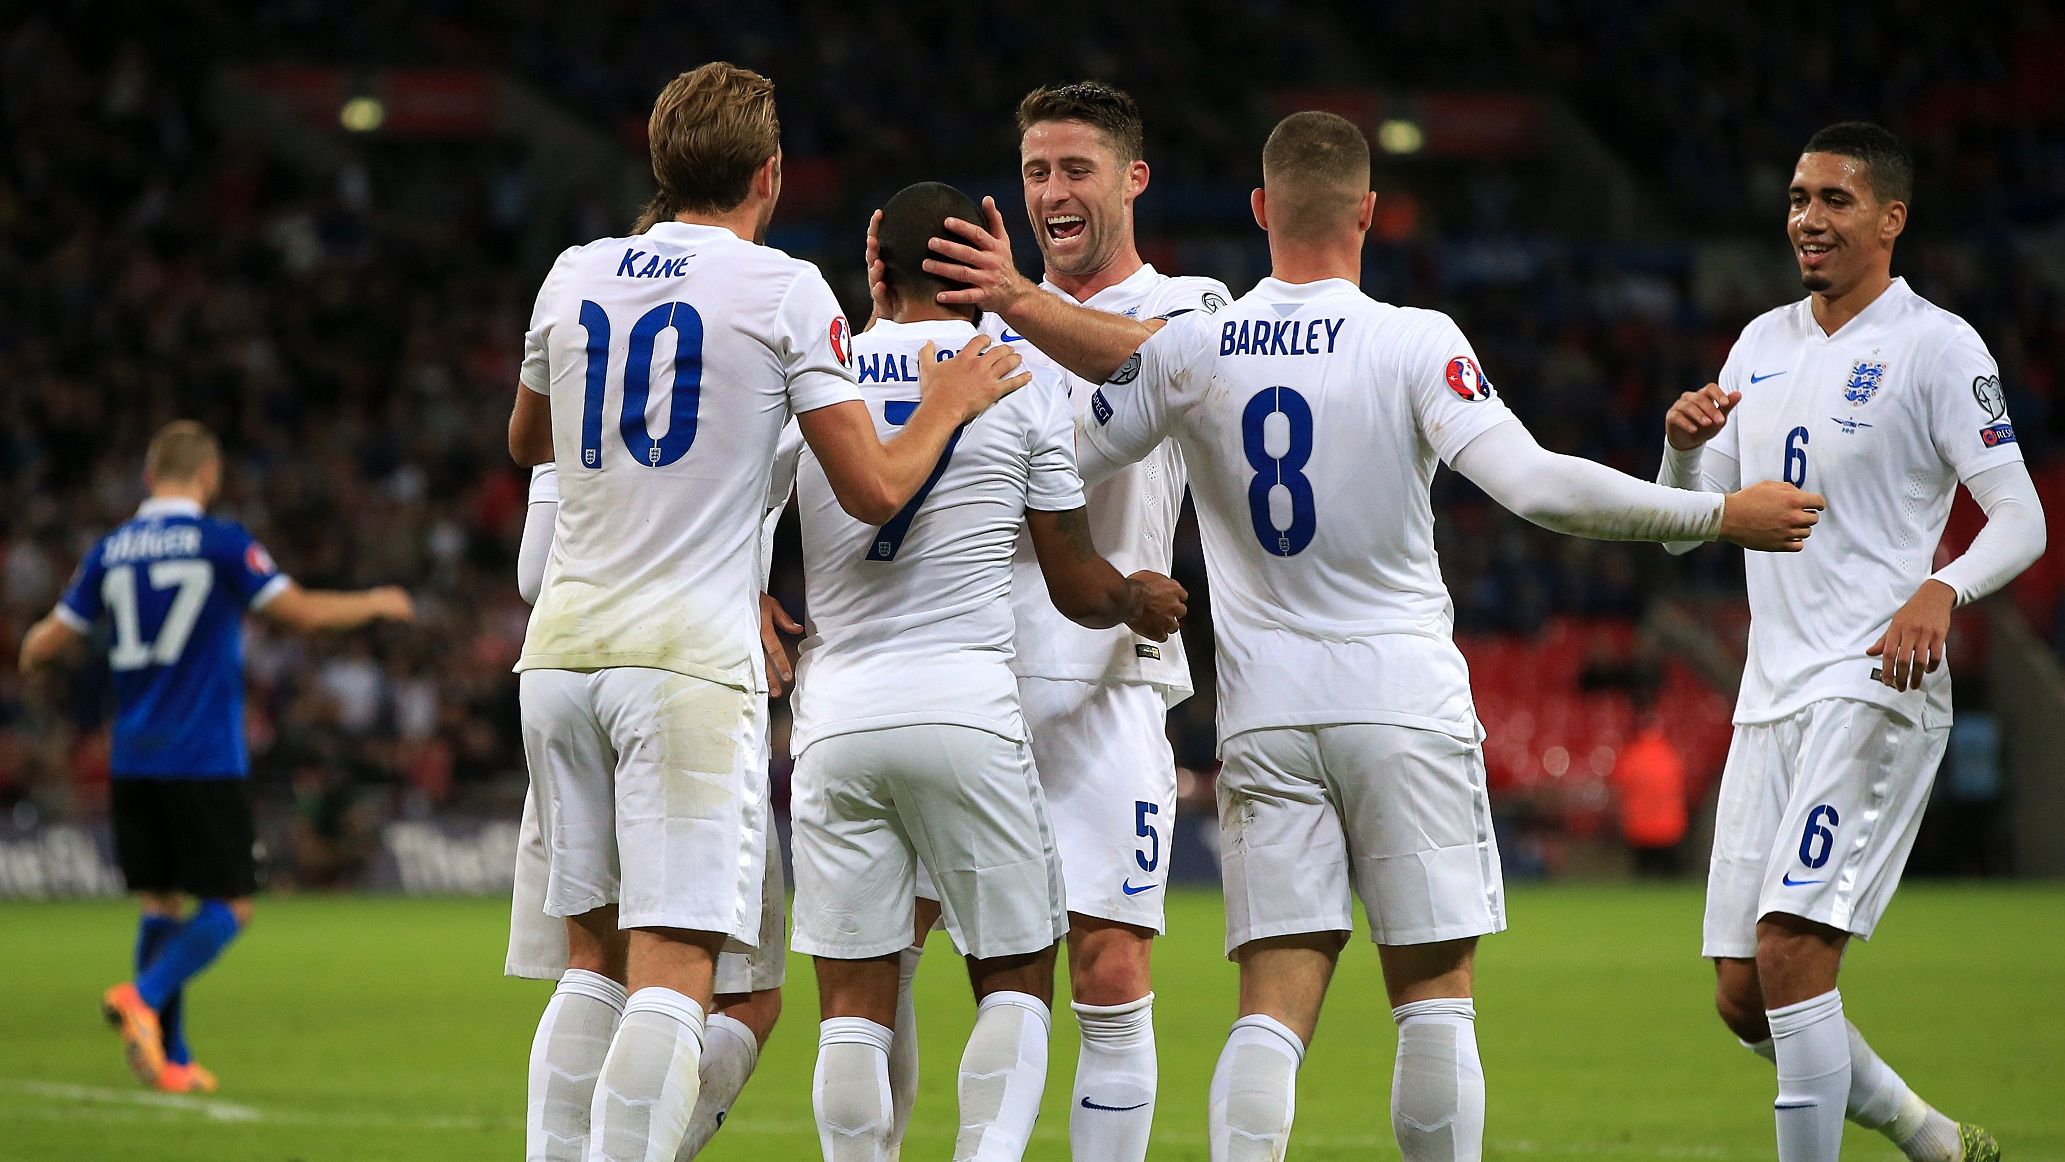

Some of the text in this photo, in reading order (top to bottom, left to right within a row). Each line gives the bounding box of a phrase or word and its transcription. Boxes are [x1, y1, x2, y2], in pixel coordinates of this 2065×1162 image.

[616, 248, 696, 278] KANE
[1220, 318, 1345, 357] BARKLEY
[578, 300, 704, 468] 10
[1242, 385, 1316, 558] 8
[1783, 426, 1809, 488] 6
[101, 558, 214, 670] 17
[1135, 801, 1159, 872] 5
[1798, 804, 1839, 869] 6
